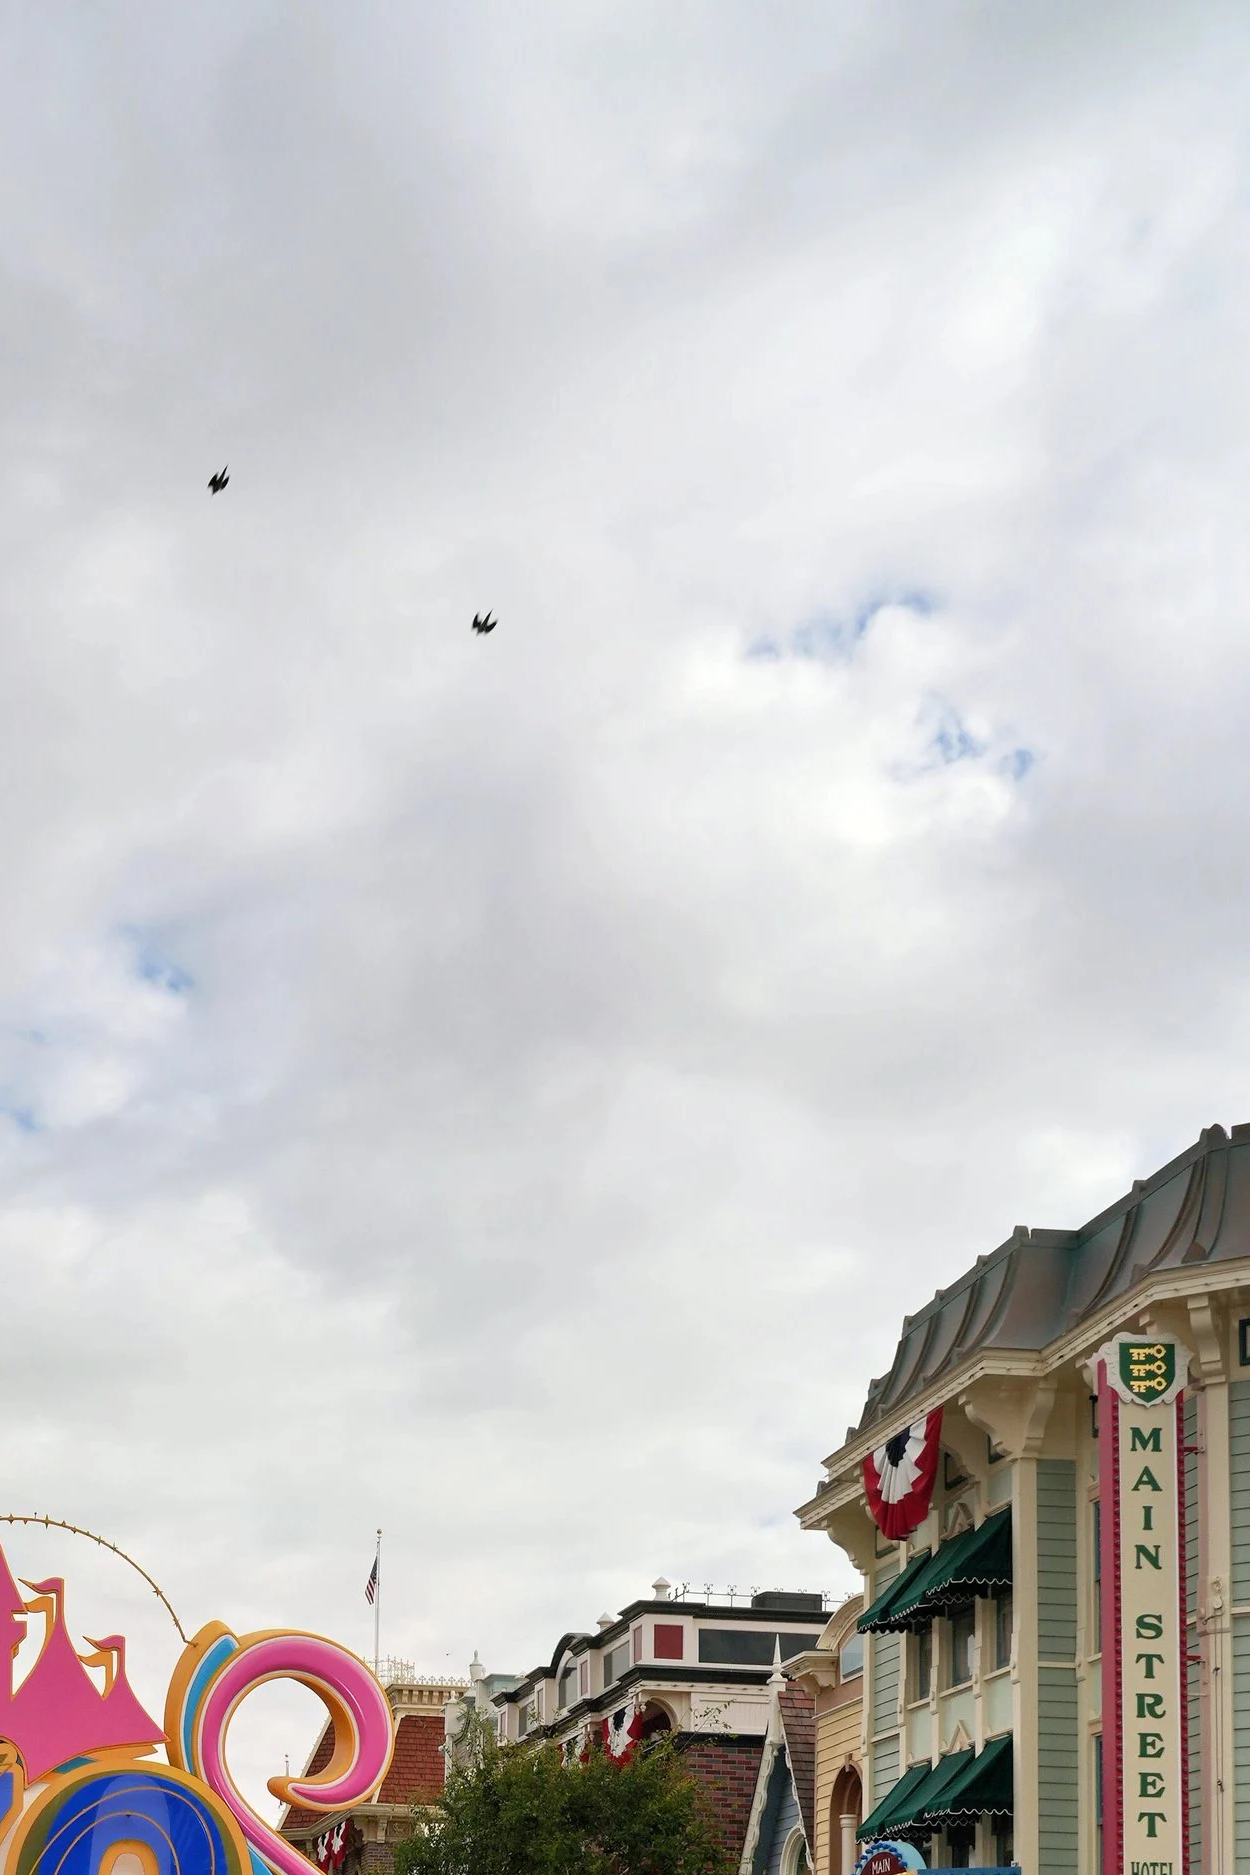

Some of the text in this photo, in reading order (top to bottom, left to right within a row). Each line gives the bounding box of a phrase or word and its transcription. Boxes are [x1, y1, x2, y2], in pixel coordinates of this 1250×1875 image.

[1130, 1426, 1167, 1839] MAIN STREET
[871, 1858, 891, 1875] MAIN
